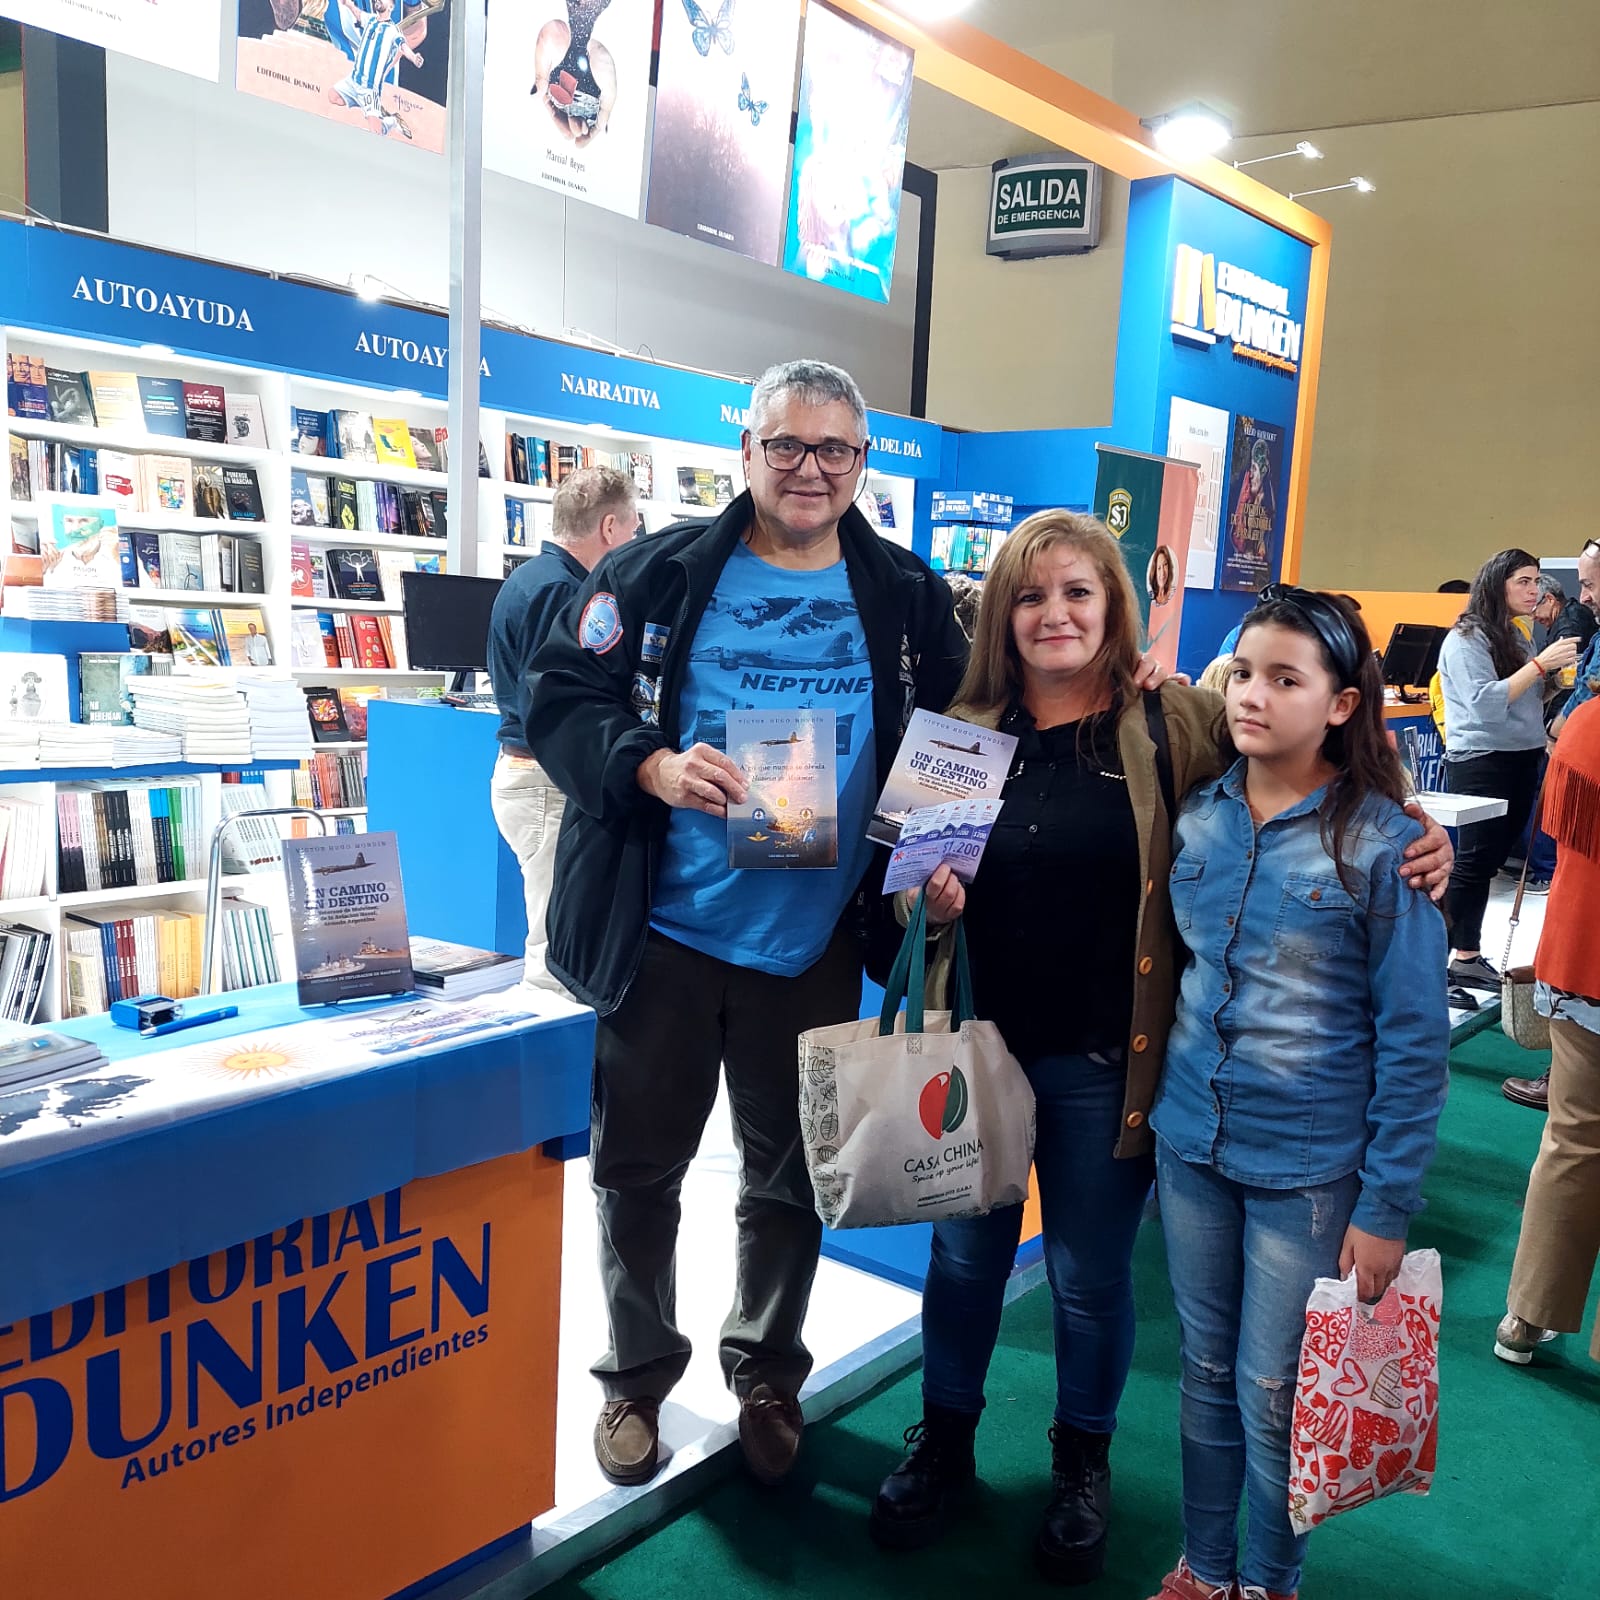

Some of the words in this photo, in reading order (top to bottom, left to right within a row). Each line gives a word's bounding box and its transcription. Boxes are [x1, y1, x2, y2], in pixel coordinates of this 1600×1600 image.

[999, 178, 1081, 210] SALIDA
[997, 214, 1009, 225] DE
[1011, 209, 1081, 223] EMERGENCIA
[71, 274, 255, 333] AUTOAYUDA
[1213, 291, 1301, 362] DUNKEN
[354, 331, 492, 377] AUTOAYA
[560, 372, 662, 411] NARRATIVA
[880, 436, 903, 455] DEL
[902, 438, 923, 458] DÍA
[740, 672, 873, 695] NEPTUNE
[909, 760, 929, 773] UN
[930, 765, 988, 790] DESTINO
[914, 751, 934, 765] UN
[936, 757, 989, 781] CAMINO
[942, 841, 981, 859] $1.200
[328, 892, 390, 909] DESTINO
[329, 882, 387, 898] CAMINO
[903, 1156, 940, 1173] CASA
[943, 1137, 984, 1163] CHINA
[946, 1163, 965, 1176] your
[0, 1221, 491, 1503] DUNKEN
[120, 1417, 257, 1490] Autores
[265, 1323, 490, 1431] Independientes
